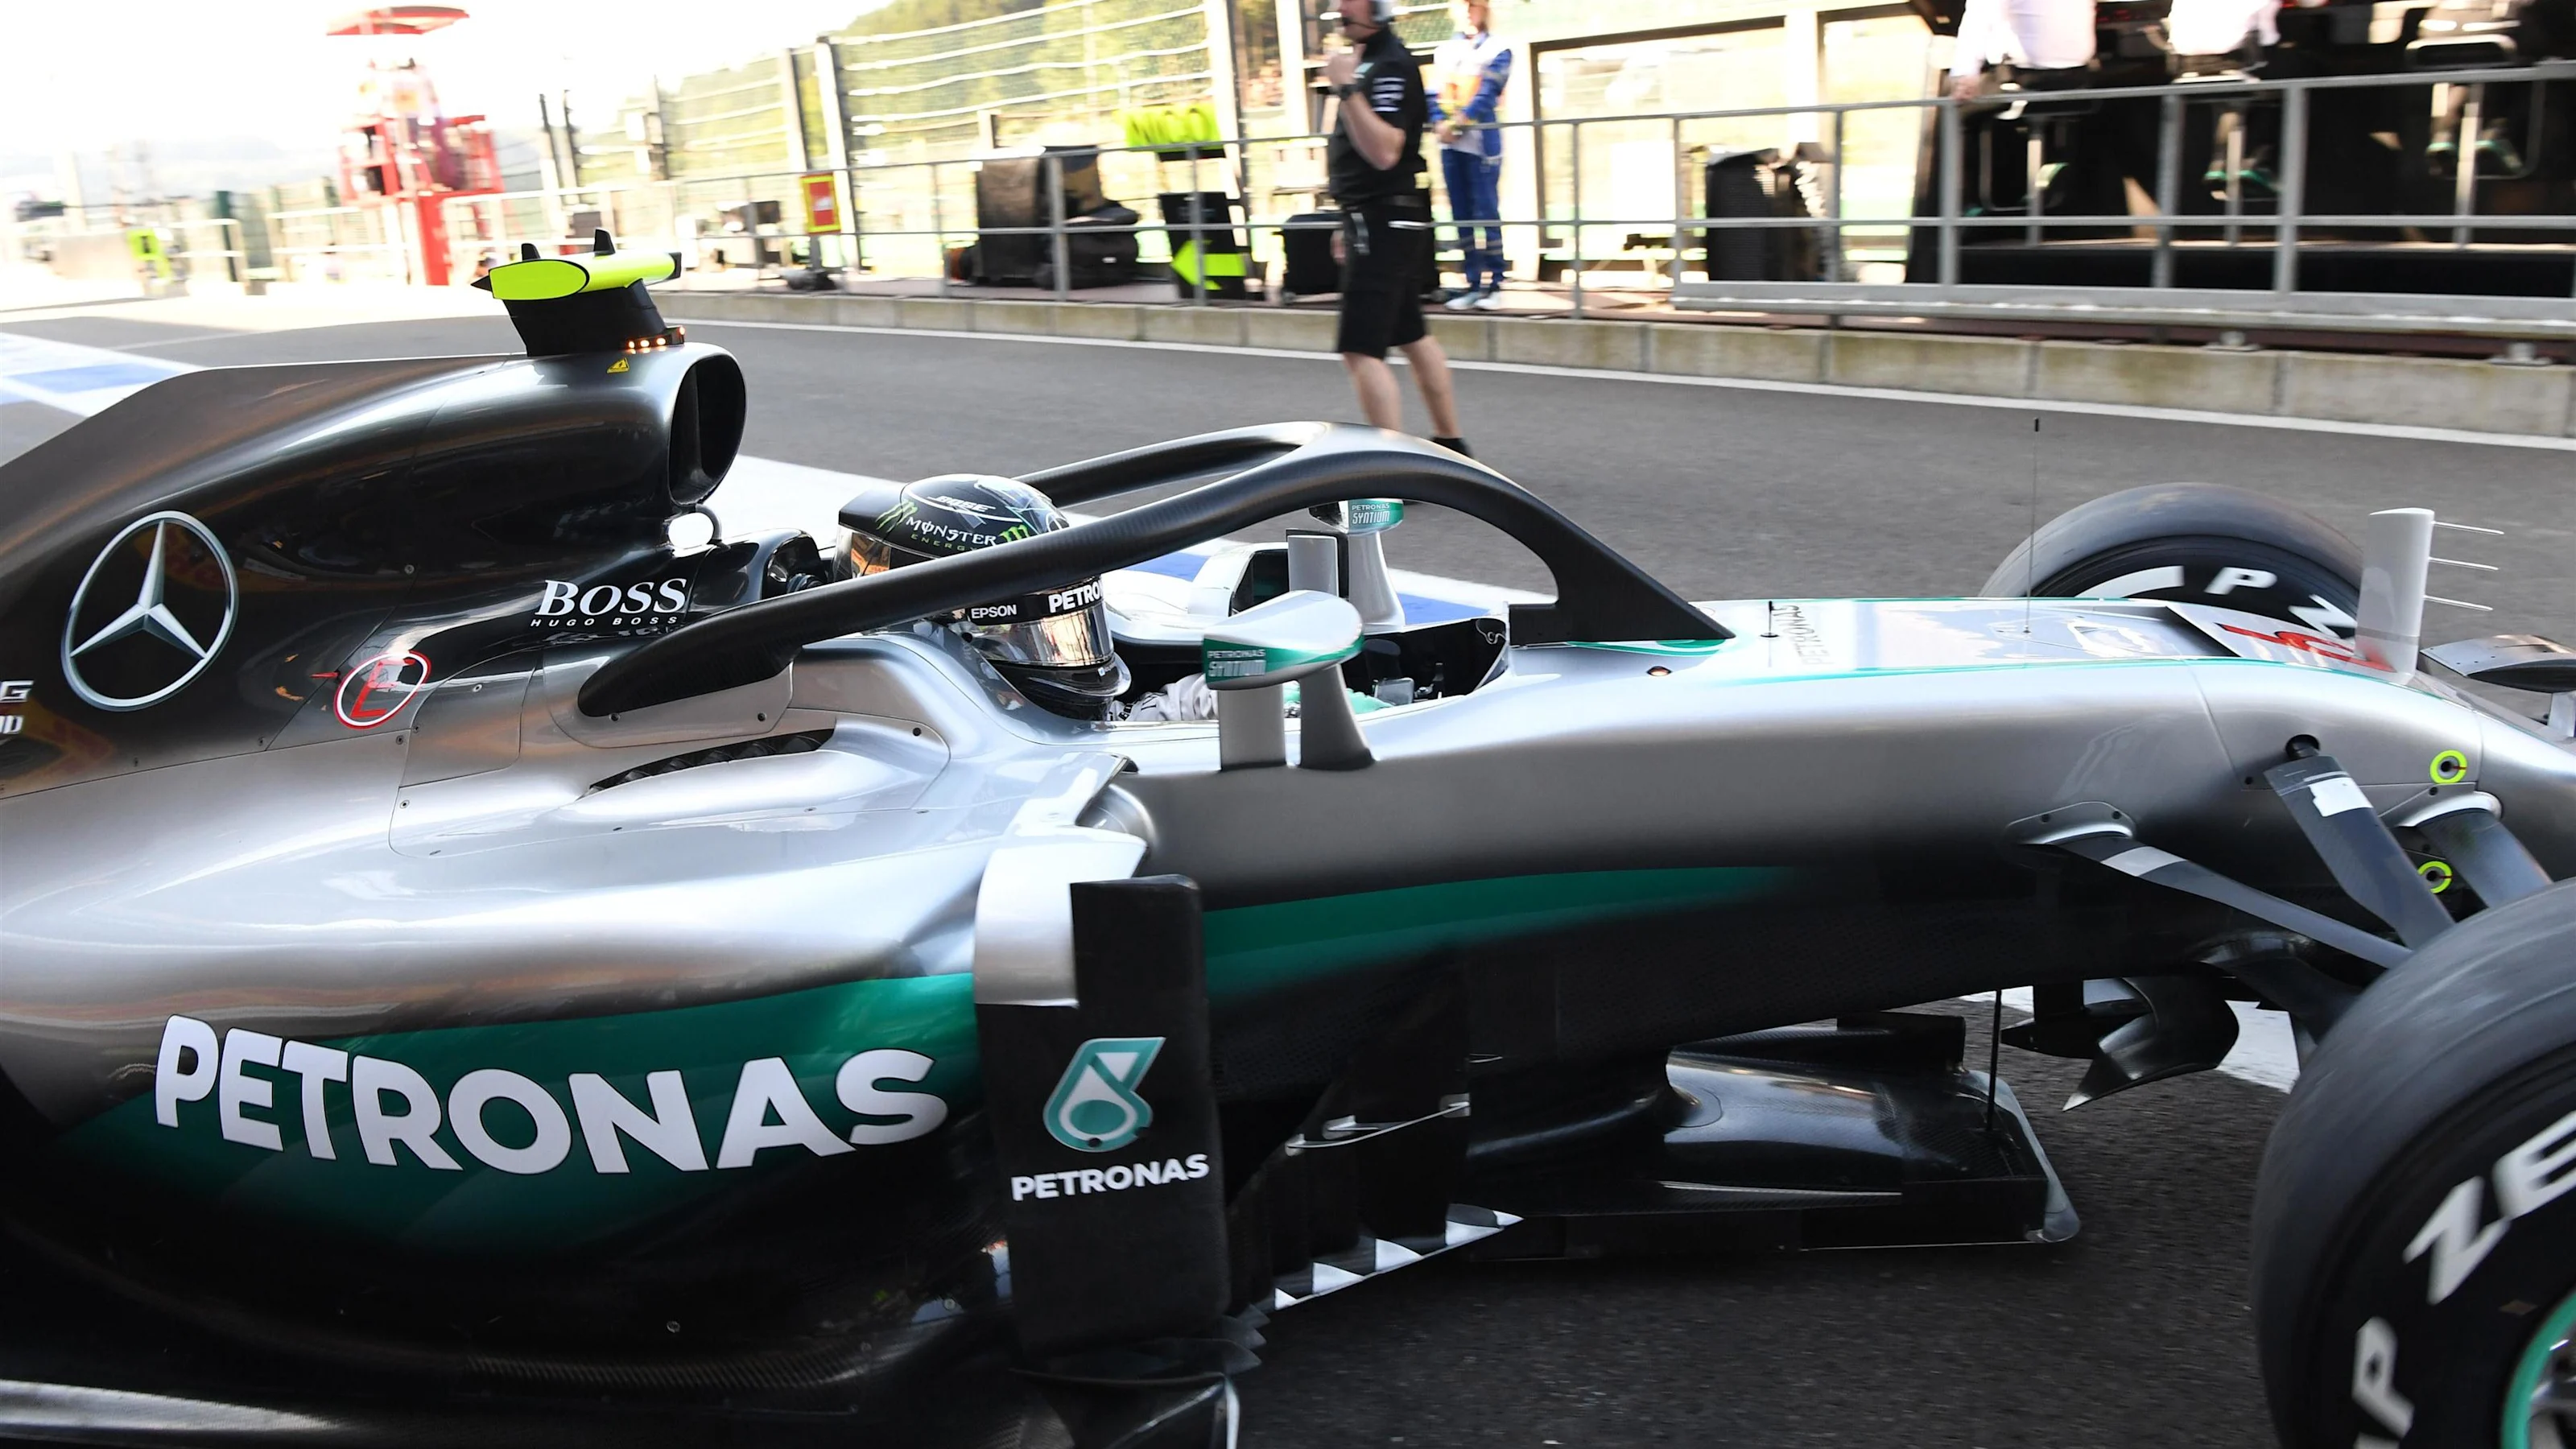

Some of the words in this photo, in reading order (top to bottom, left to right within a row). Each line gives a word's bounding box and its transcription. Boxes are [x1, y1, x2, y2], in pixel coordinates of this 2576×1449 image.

[928, 495, 997, 513] BOSE
[1352, 502, 1390, 511] PETRONAS
[1352, 510, 1390, 525] SYNTIUM
[906, 516, 997, 547] MONSTER
[535, 578, 687, 617] BOSS
[971, 604, 1018, 620] EPSON
[530, 618, 595, 627] HUGO
[612, 616, 678, 625] BOSS
[154, 1013, 948, 1174] PETRONAS
[1011, 1154, 1210, 1201] PETRONAS
